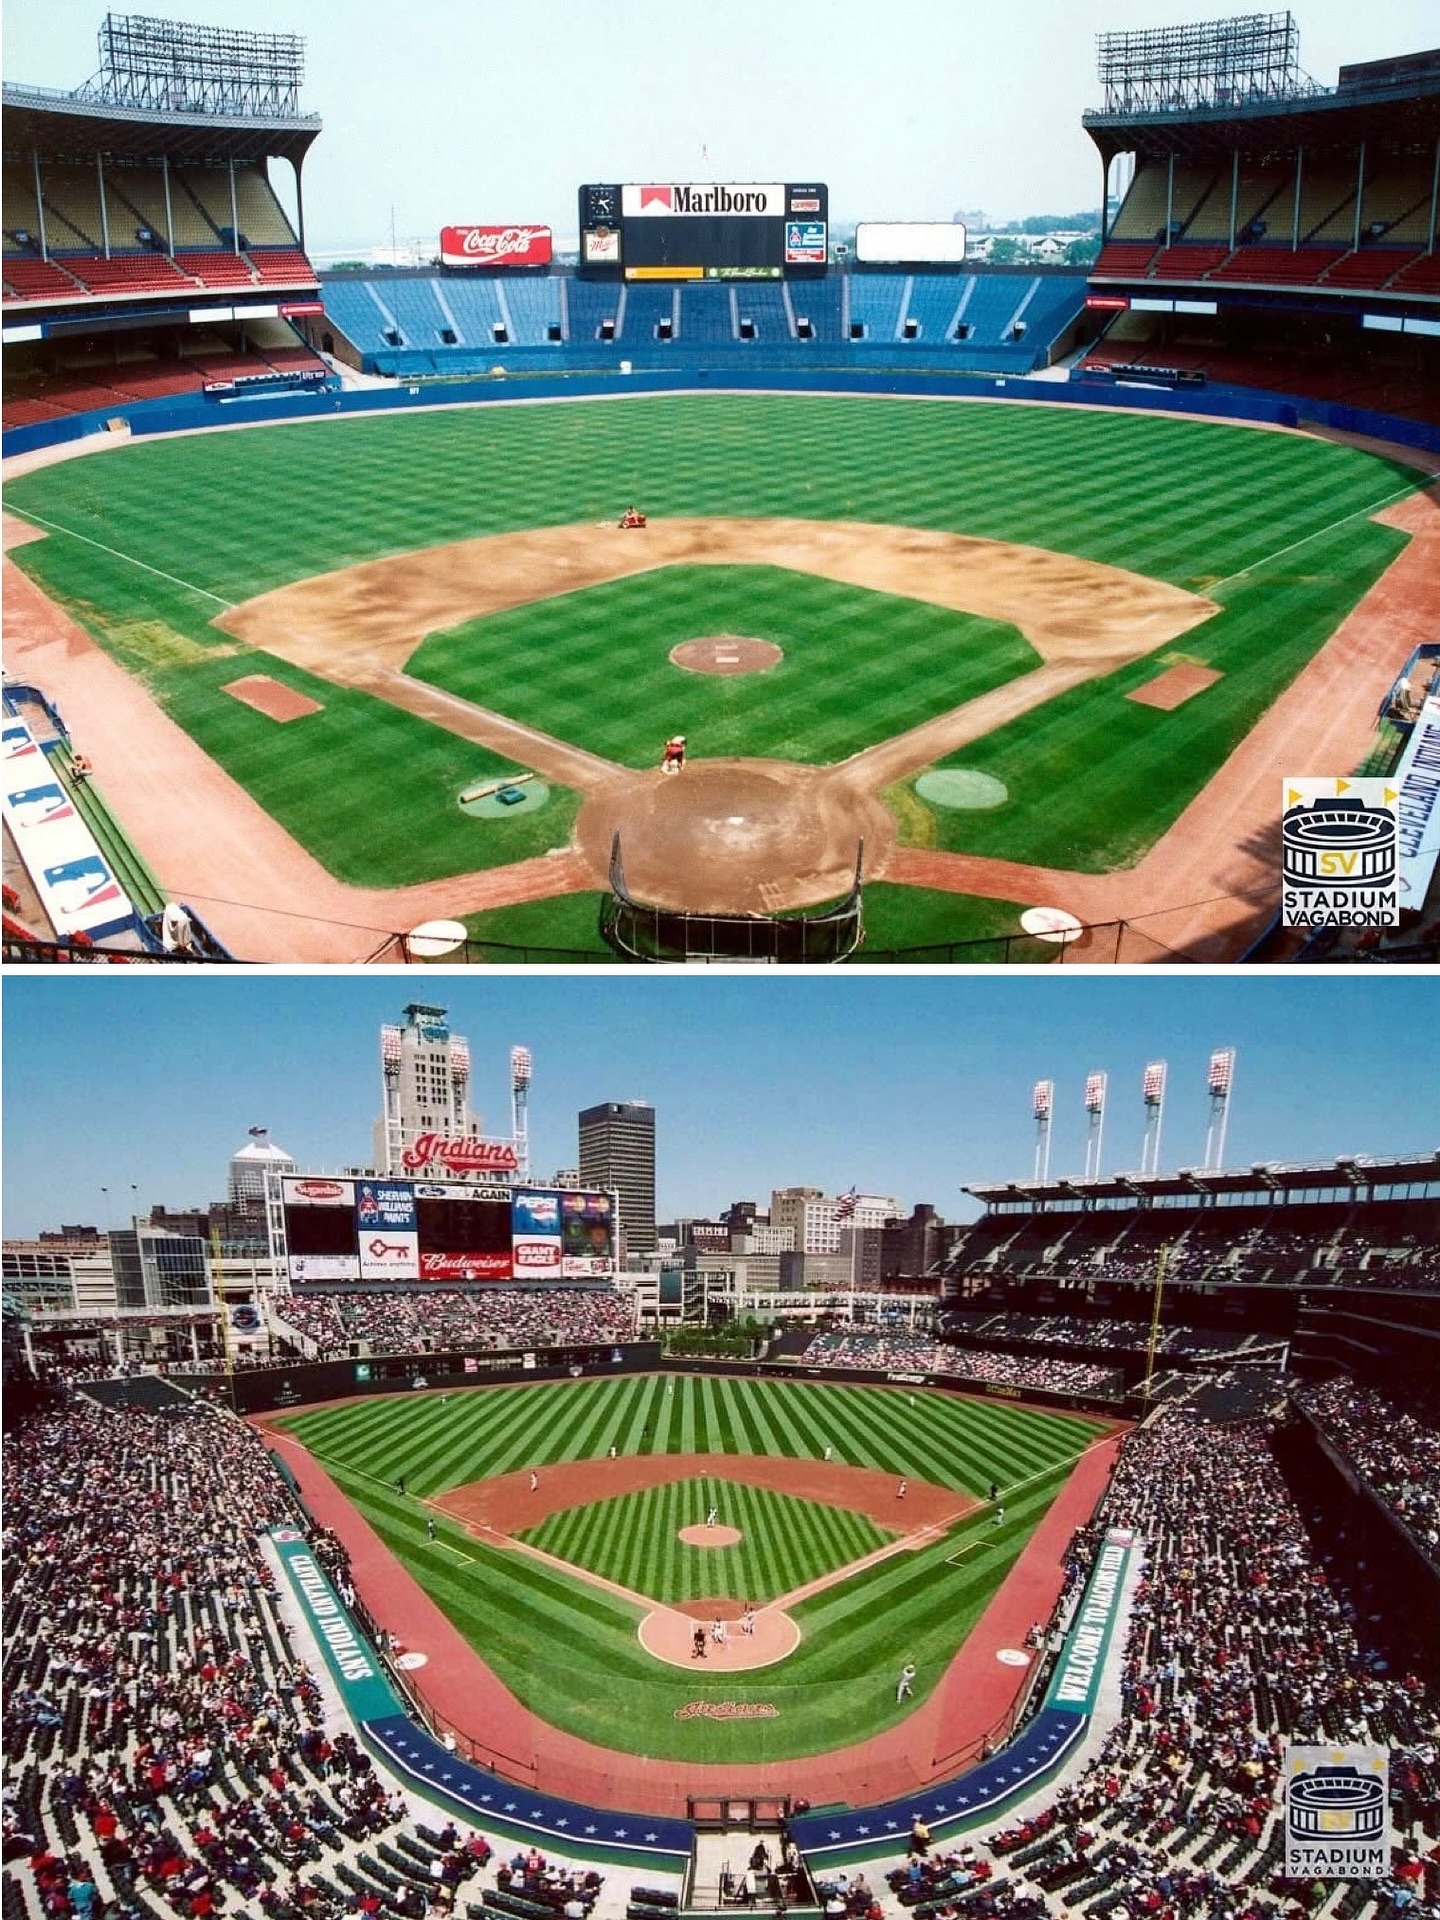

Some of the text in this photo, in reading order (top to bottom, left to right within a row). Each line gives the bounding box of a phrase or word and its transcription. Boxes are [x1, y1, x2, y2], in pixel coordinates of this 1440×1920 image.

[673, 186, 767, 213] Marlboro
[402, 1132, 519, 1172] Indians
[472, 1189, 511, 1200] AGAIN
[421, 1253, 511, 1270] Budweiser
[318, 1616, 374, 1680] INDIANS
[1056, 1625, 1105, 1701] WELCOME
